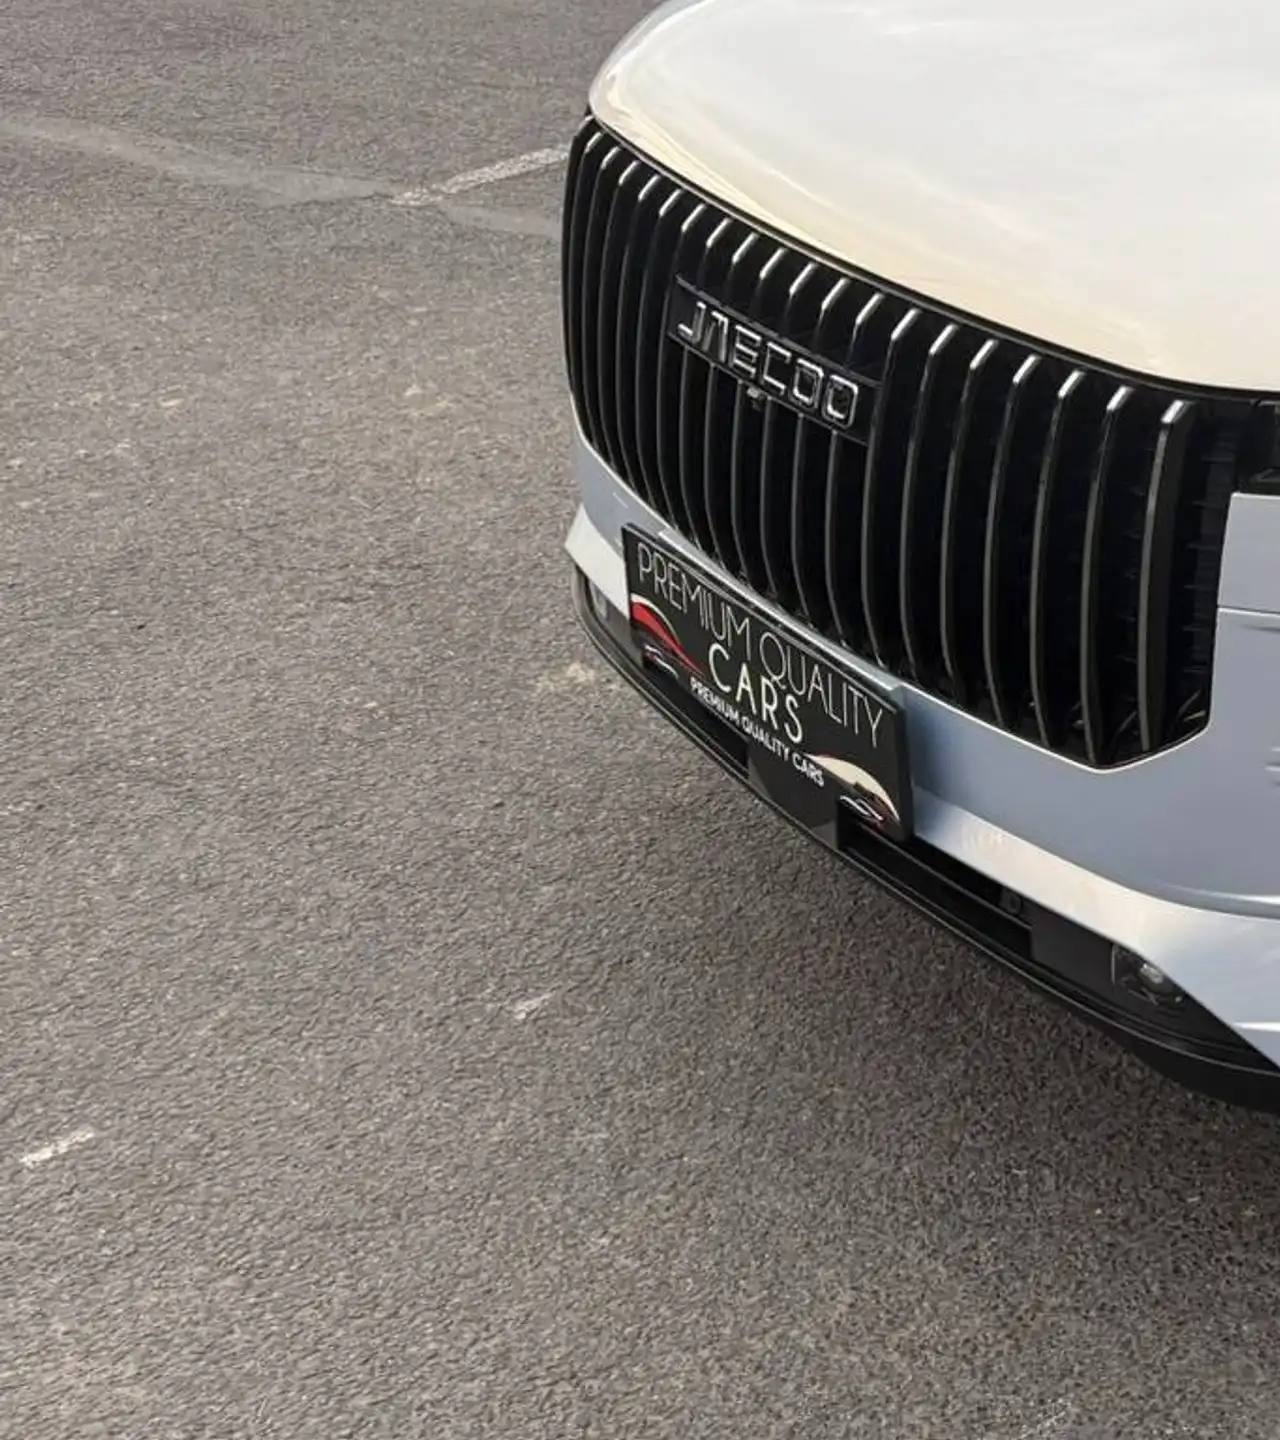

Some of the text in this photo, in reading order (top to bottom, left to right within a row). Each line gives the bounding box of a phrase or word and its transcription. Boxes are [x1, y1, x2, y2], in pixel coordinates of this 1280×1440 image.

[677, 301, 860, 429] JAECOO
[637, 542, 883, 748] PREMIUM QUALITY
[708, 642, 803, 744] CARS
[690, 676, 825, 787] PREMIUM QUALITY CARS
